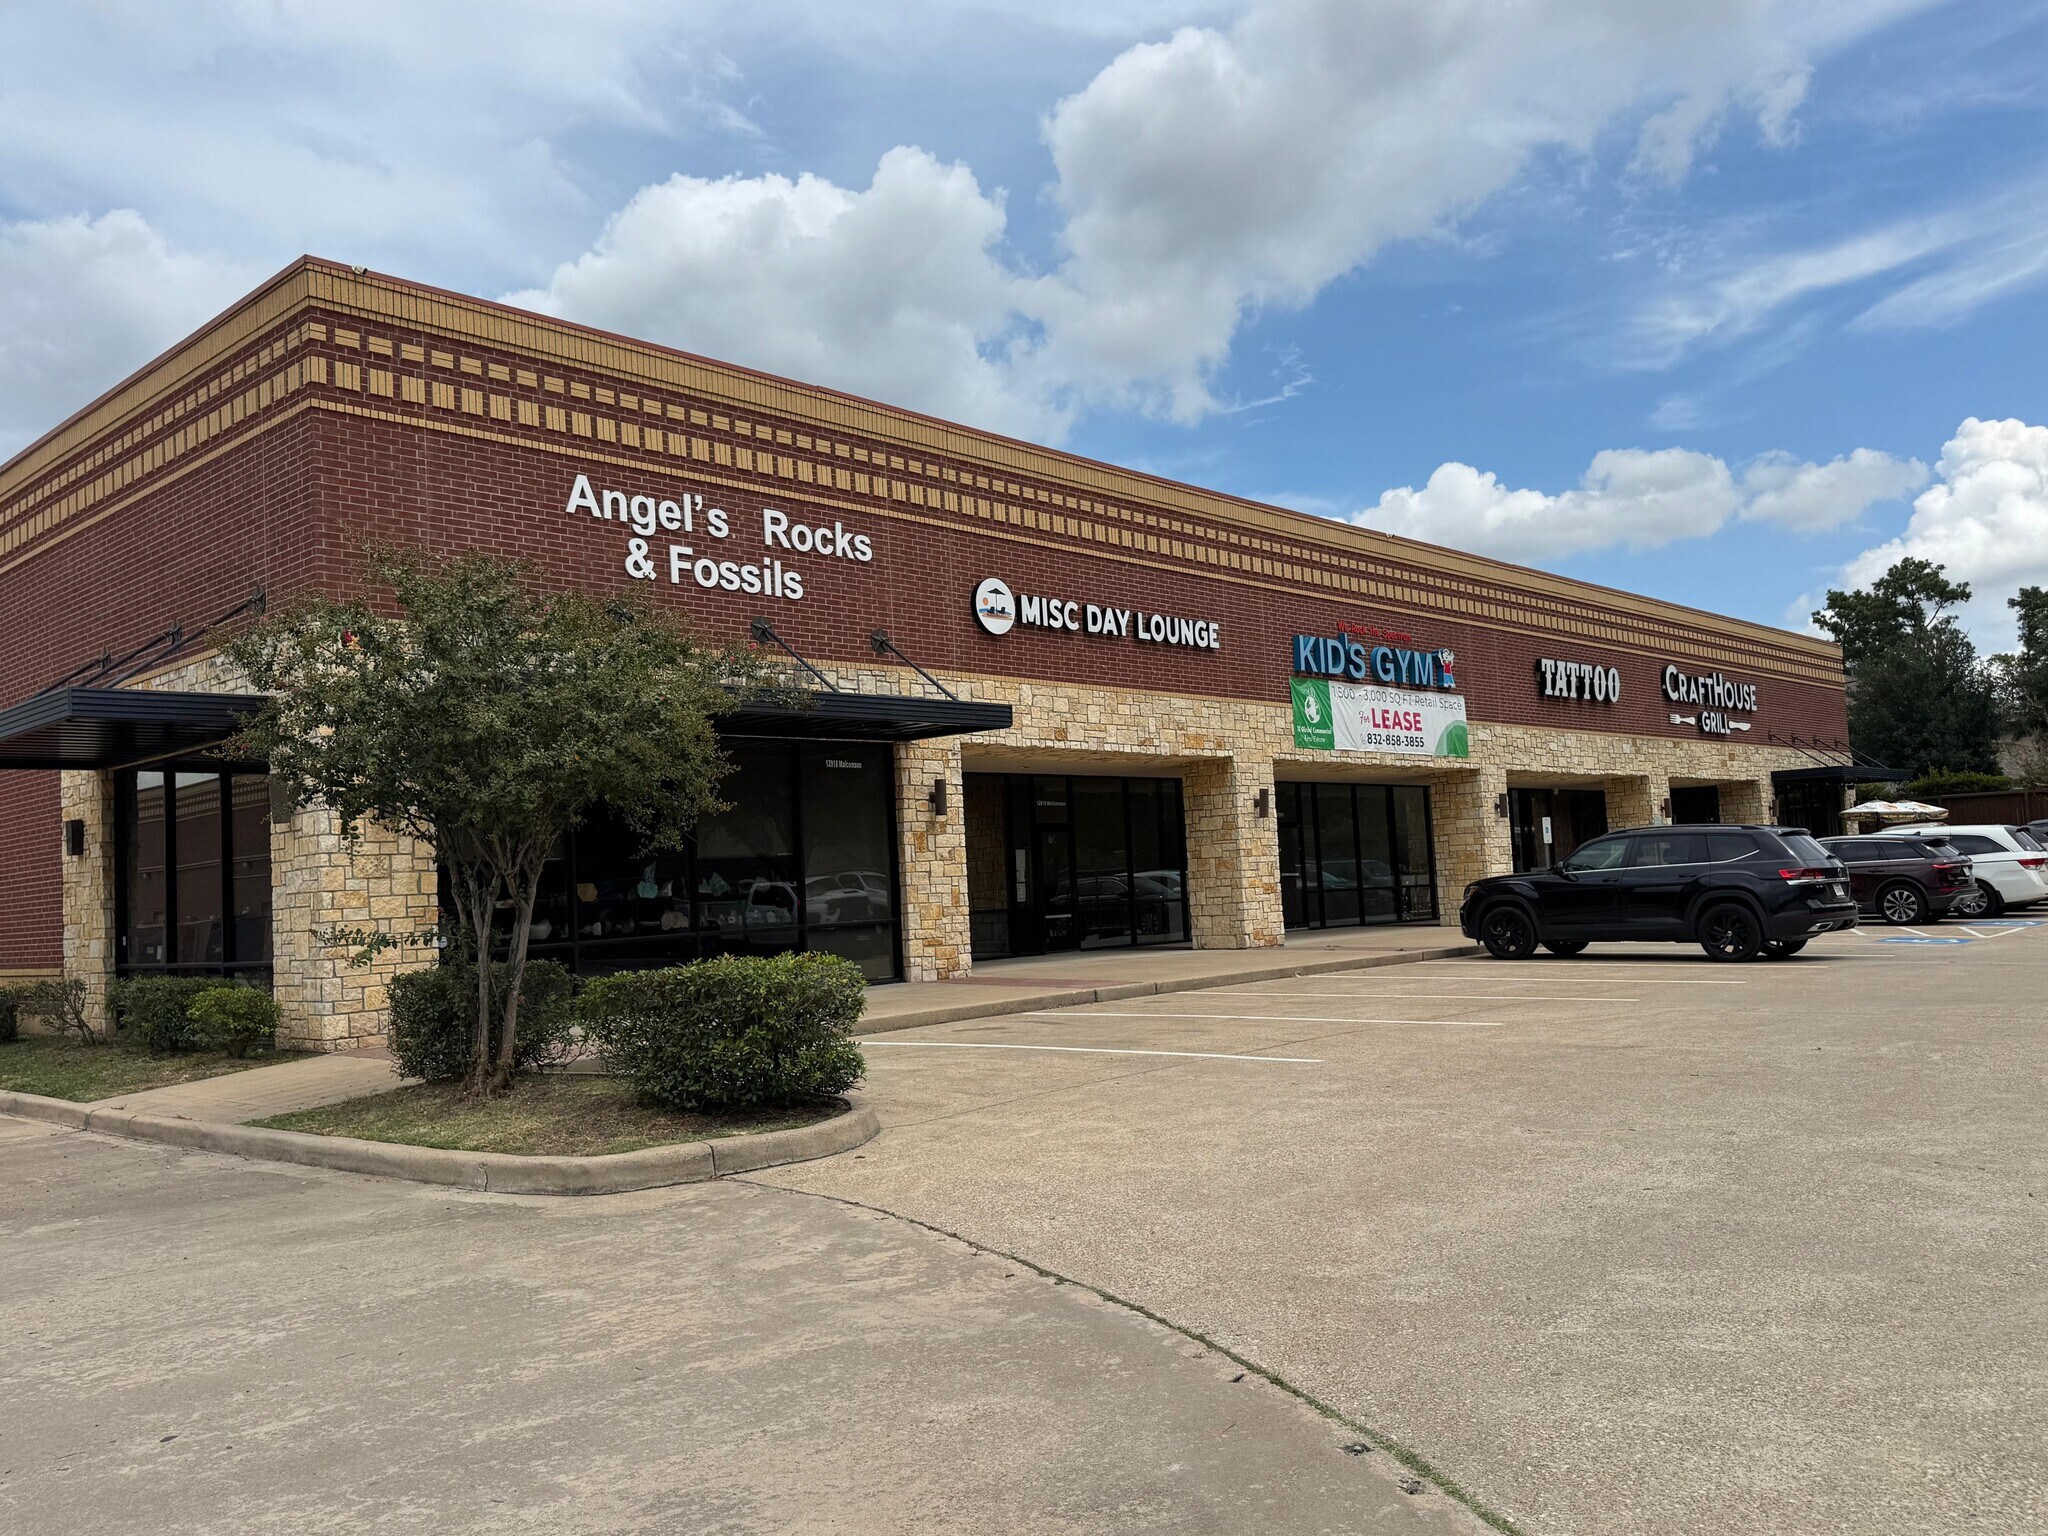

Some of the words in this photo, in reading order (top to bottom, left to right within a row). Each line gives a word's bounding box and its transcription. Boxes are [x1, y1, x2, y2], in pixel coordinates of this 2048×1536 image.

[565, 473, 730, 538] Angel's
[762, 507, 874, 562] Rocks
[624, 537, 657, 581] &
[669, 543, 804, 600] Fossils
[1018, 593, 1080, 631] MISC
[1085, 603, 1131, 637] DAY
[1135, 611, 1220, 649] LOUNGE
[1294, 633, 1367, 680] KID'S
[1372, 646, 1434, 687] GYM
[1538, 658, 1621, 703] TATTOO
[1363, 689, 1387, 703] 3,000
[1415, 695, 1437, 709] Retail
[1439, 697, 1463, 711] Space
[1371, 708, 1423, 732] LEASE
[1700, 710, 1731, 735] GRILL
[1367, 733, 1425, 748] 832-858-3855
